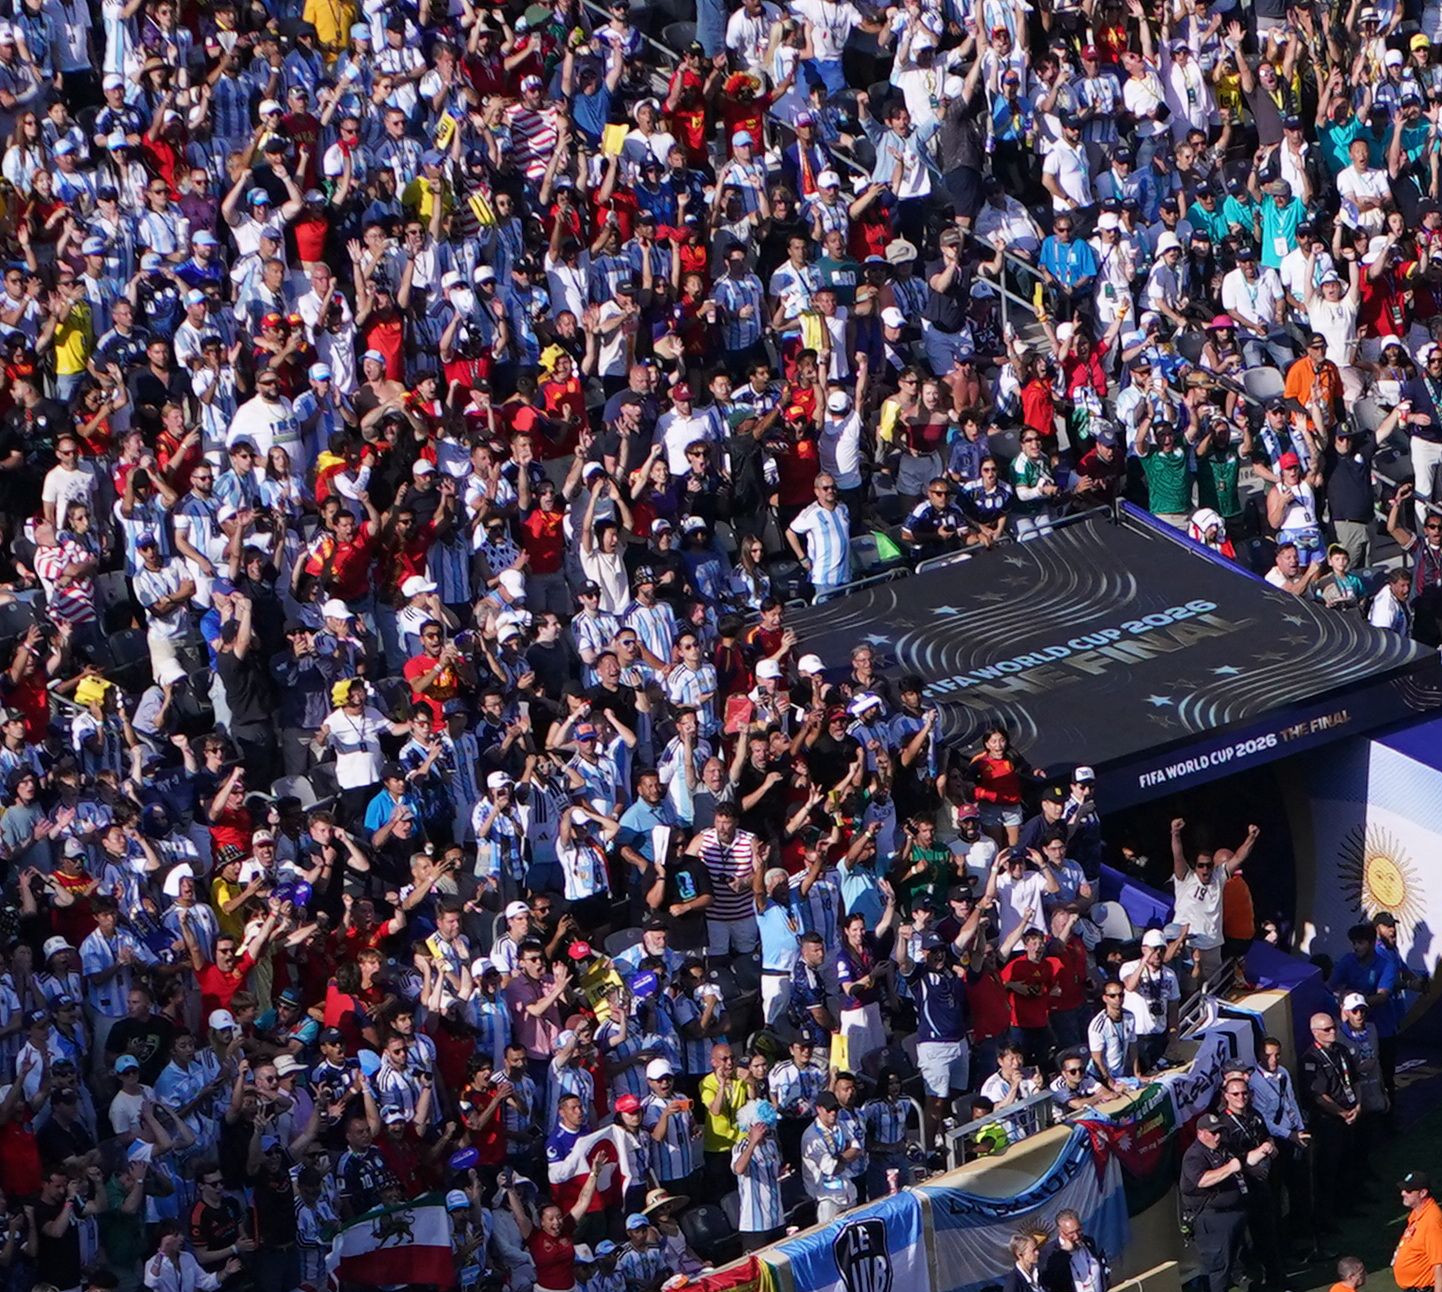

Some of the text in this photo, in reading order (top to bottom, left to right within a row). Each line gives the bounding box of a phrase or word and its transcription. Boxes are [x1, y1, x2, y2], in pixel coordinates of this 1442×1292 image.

[922, 599, 1218, 699] FIFA WORLD CUP 2026
[947, 613, 1255, 711] THE FINAL
[1138, 709, 1352, 789] FIFA WORLD CUP 2026 THE FINAL
[848, 1224, 871, 1256] LE
